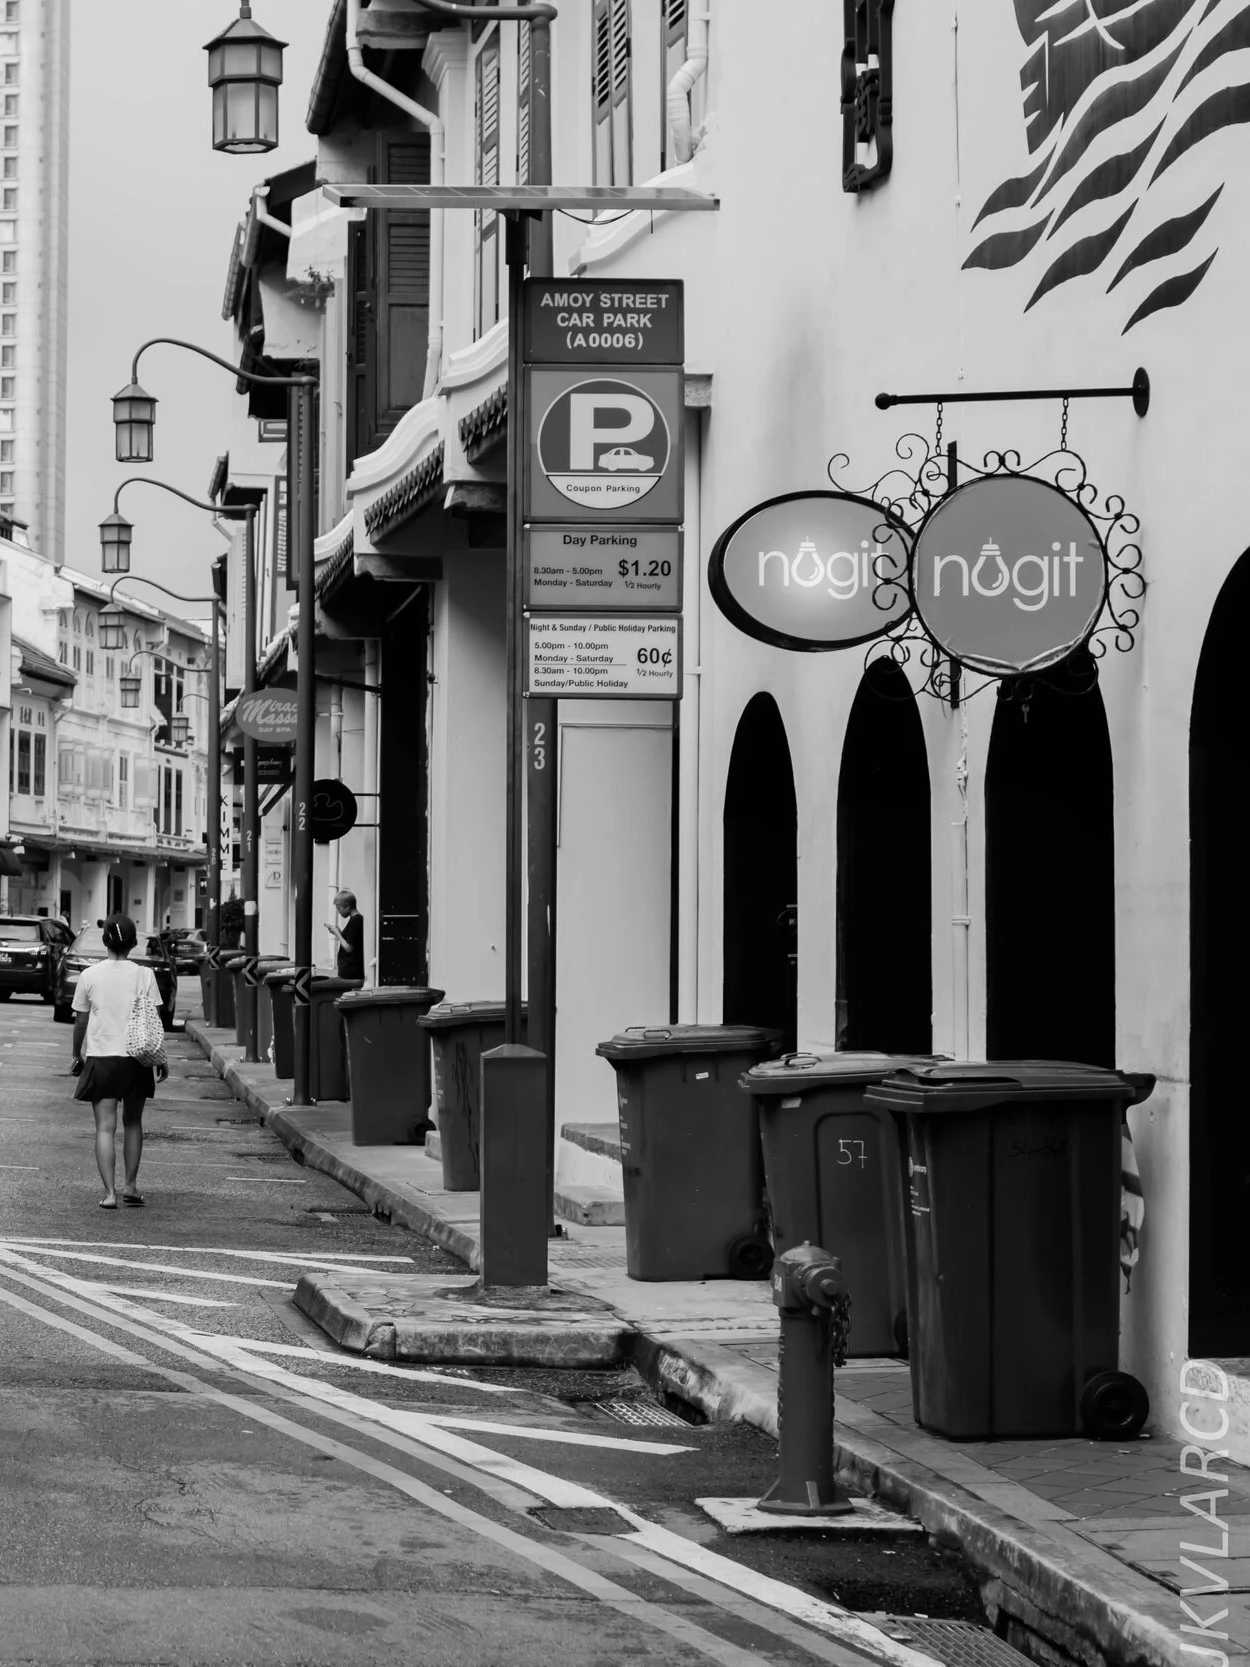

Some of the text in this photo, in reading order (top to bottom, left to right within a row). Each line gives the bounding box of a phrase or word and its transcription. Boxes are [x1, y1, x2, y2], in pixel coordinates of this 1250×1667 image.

[540, 293, 669, 308] AMOY STREET
[557, 312, 652, 328] CAR PARK
[566, 331, 643, 350] (A0006)
[569, 393, 655, 470] P
[566, 483, 641, 494] Coupon Parking
[563, 534, 638, 548] Day Parking
[534, 567, 564, 575] 8.30am
[572, 567, 603, 576] 5.00pm
[618, 558, 671, 578] $1.20
[534, 579, 568, 587] Monday
[575, 579, 613, 588] Saturday
[637, 582, 661, 591] Hourly
[530, 623, 550, 632] Night
[559, 624, 587, 632] Sunday
[593, 624, 617, 632] Public
[618, 624, 646, 633] Holiday
[647, 625, 676, 634] Parking
[534, 642, 565, 650] 5.00pm
[574, 642, 609, 651] 10.00pm
[534, 654, 568, 663] Monday
[576, 654, 614, 663] Saturday
[637, 647, 672, 668] 60¢
[534, 667, 564, 675] 8.30am
[573, 667, 608, 676] 10.00pm
[648, 670, 673, 678] Hourly
[534, 680, 629, 689] Sunday/Public Holiday
[534, 722, 546, 770] 23
[299, 802, 306, 830] 22
[246, 830, 252, 852] 21
[837, 1139, 869, 1169] 57
